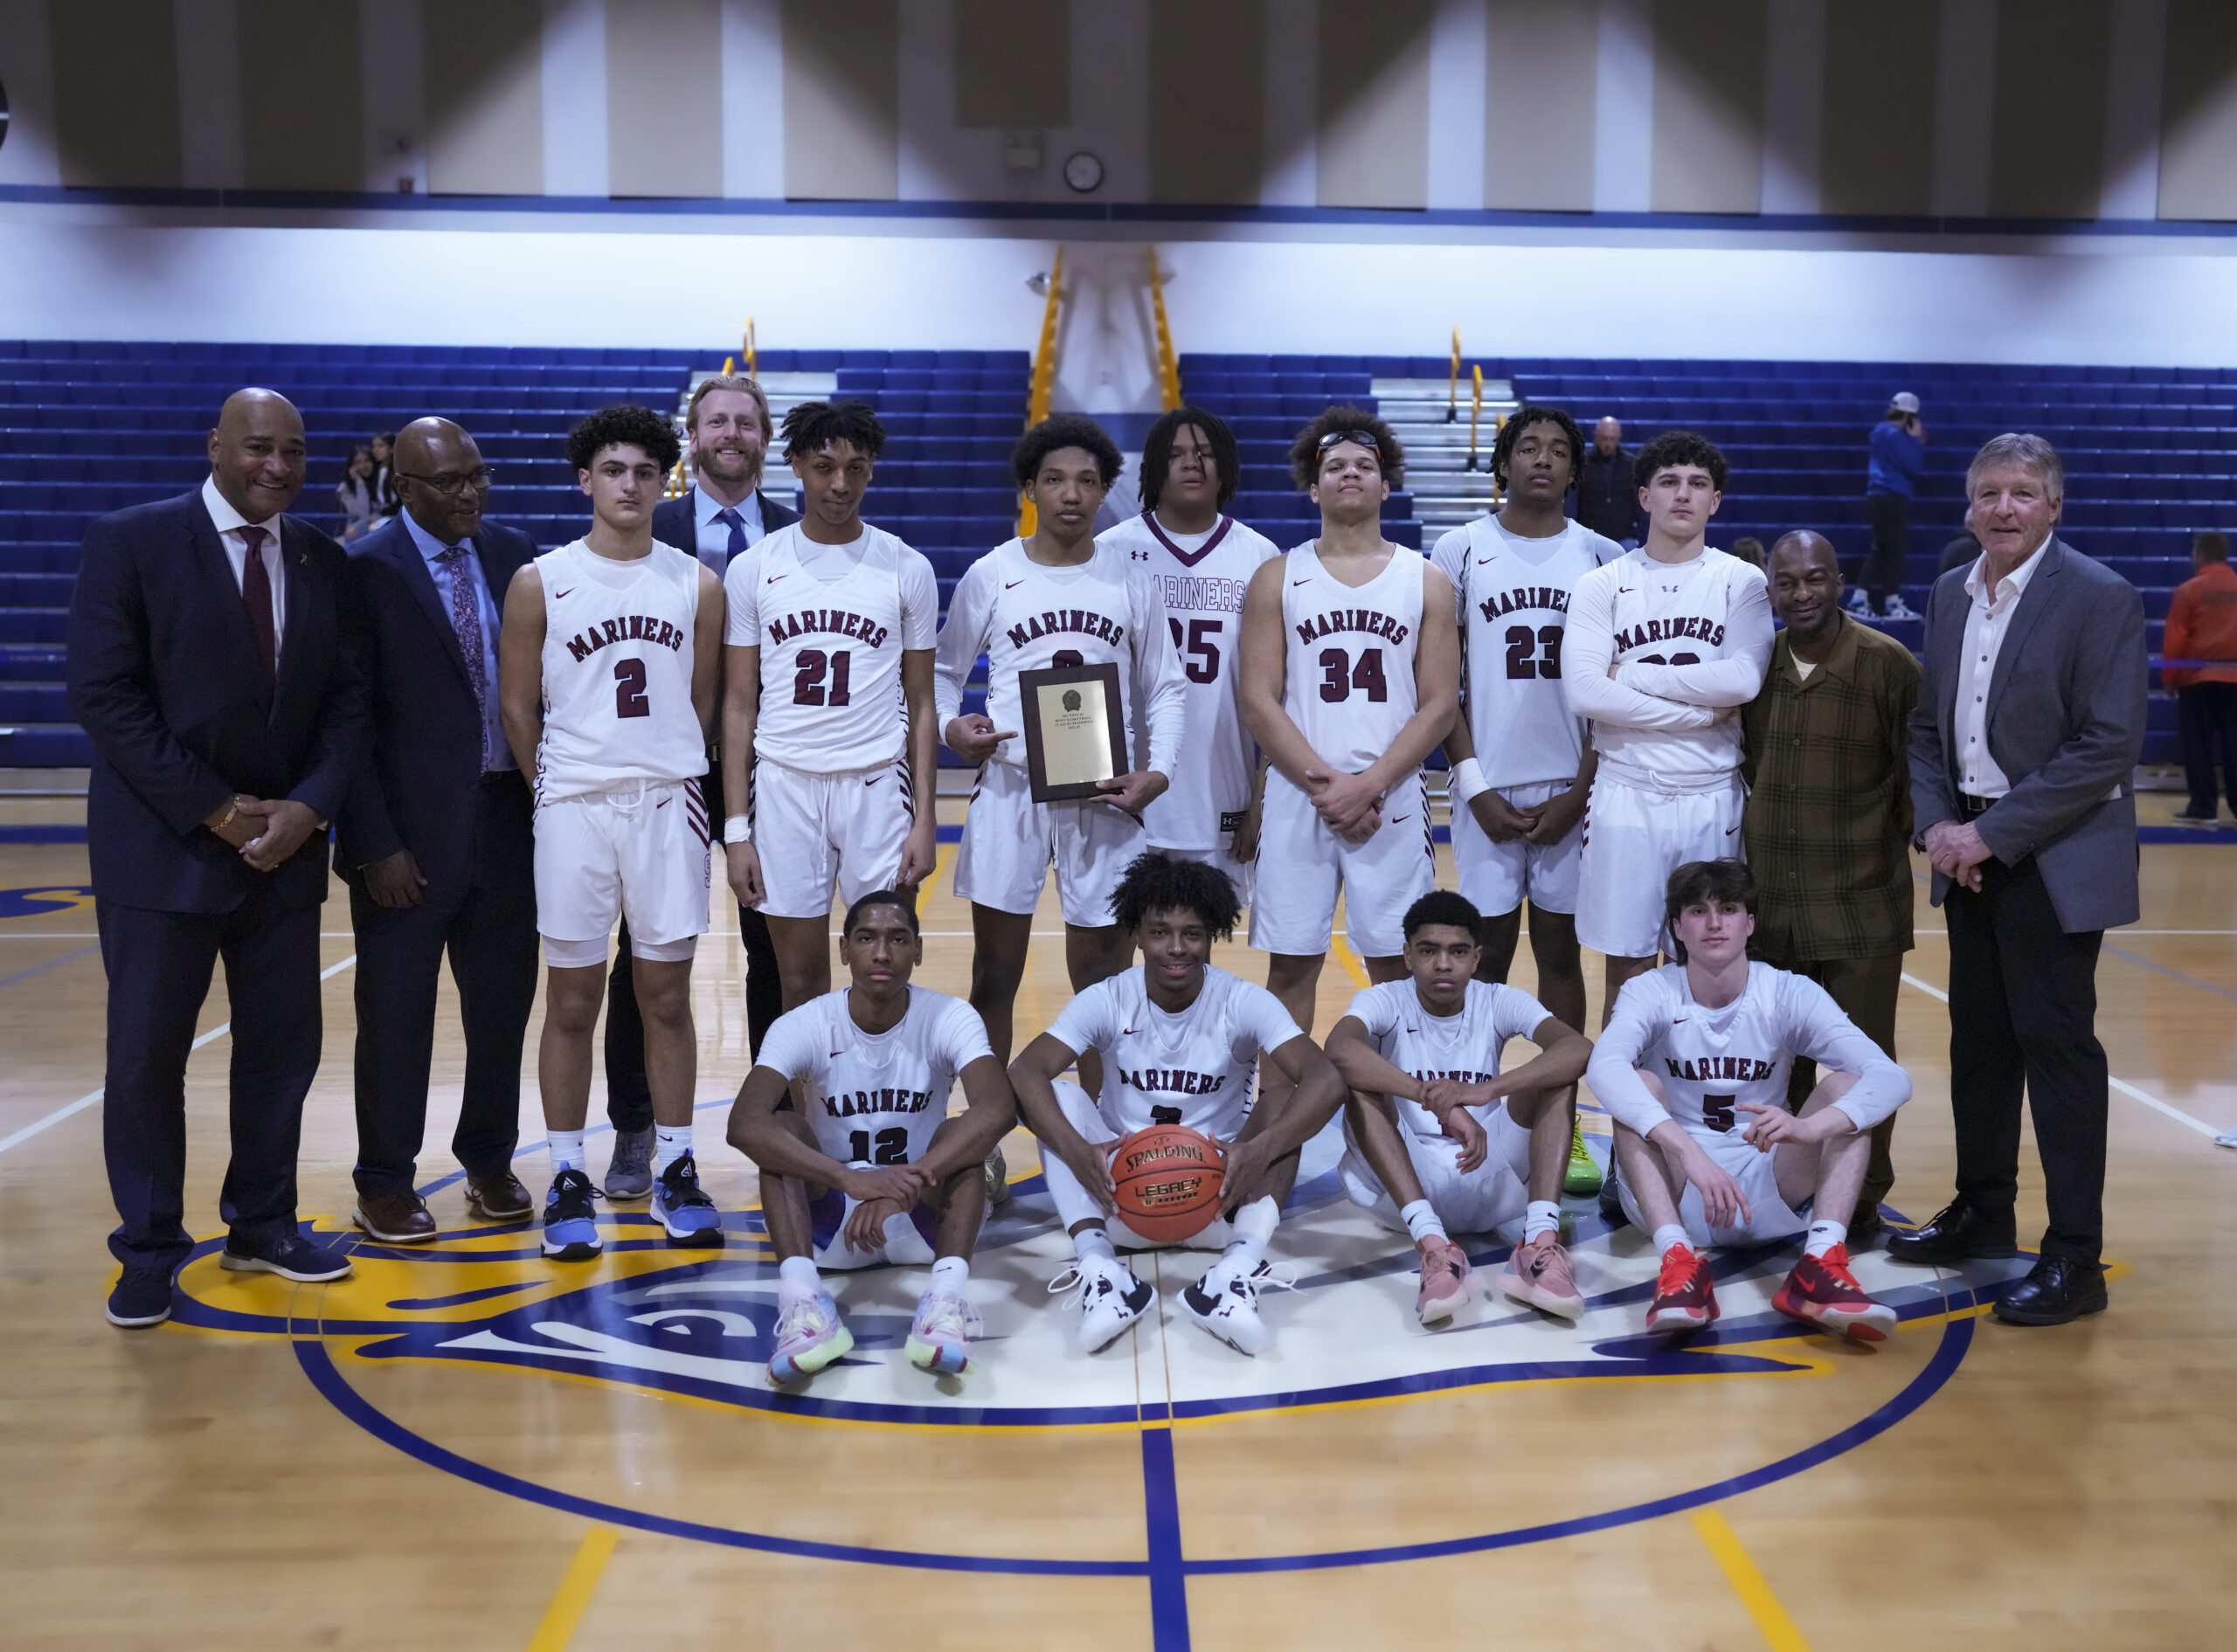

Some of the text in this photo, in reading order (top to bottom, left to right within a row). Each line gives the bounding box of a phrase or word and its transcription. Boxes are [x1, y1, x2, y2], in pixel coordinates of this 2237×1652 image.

[565, 615, 684, 663] MARINERS
[769, 609, 888, 648] MARINERS
[1007, 609, 1124, 650] MARINERS
[1296, 609, 1409, 646] MARINERS
[1614, 616, 1725, 654] MARINERS
[1505, 626, 1565, 680] 23
[613, 657, 650, 719] 2
[793, 649, 851, 707] 21
[1319, 647, 1388, 703] 34
[1665, 1056, 1772, 1082] MARINERS
[821, 1089, 933, 1117] MARINERS
[1702, 1094, 1736, 1133] 5
[848, 1126, 909, 1165] 12
[1125, 1144, 1203, 1172] SPALDING
[1135, 1176, 1202, 1198] LEGACY
